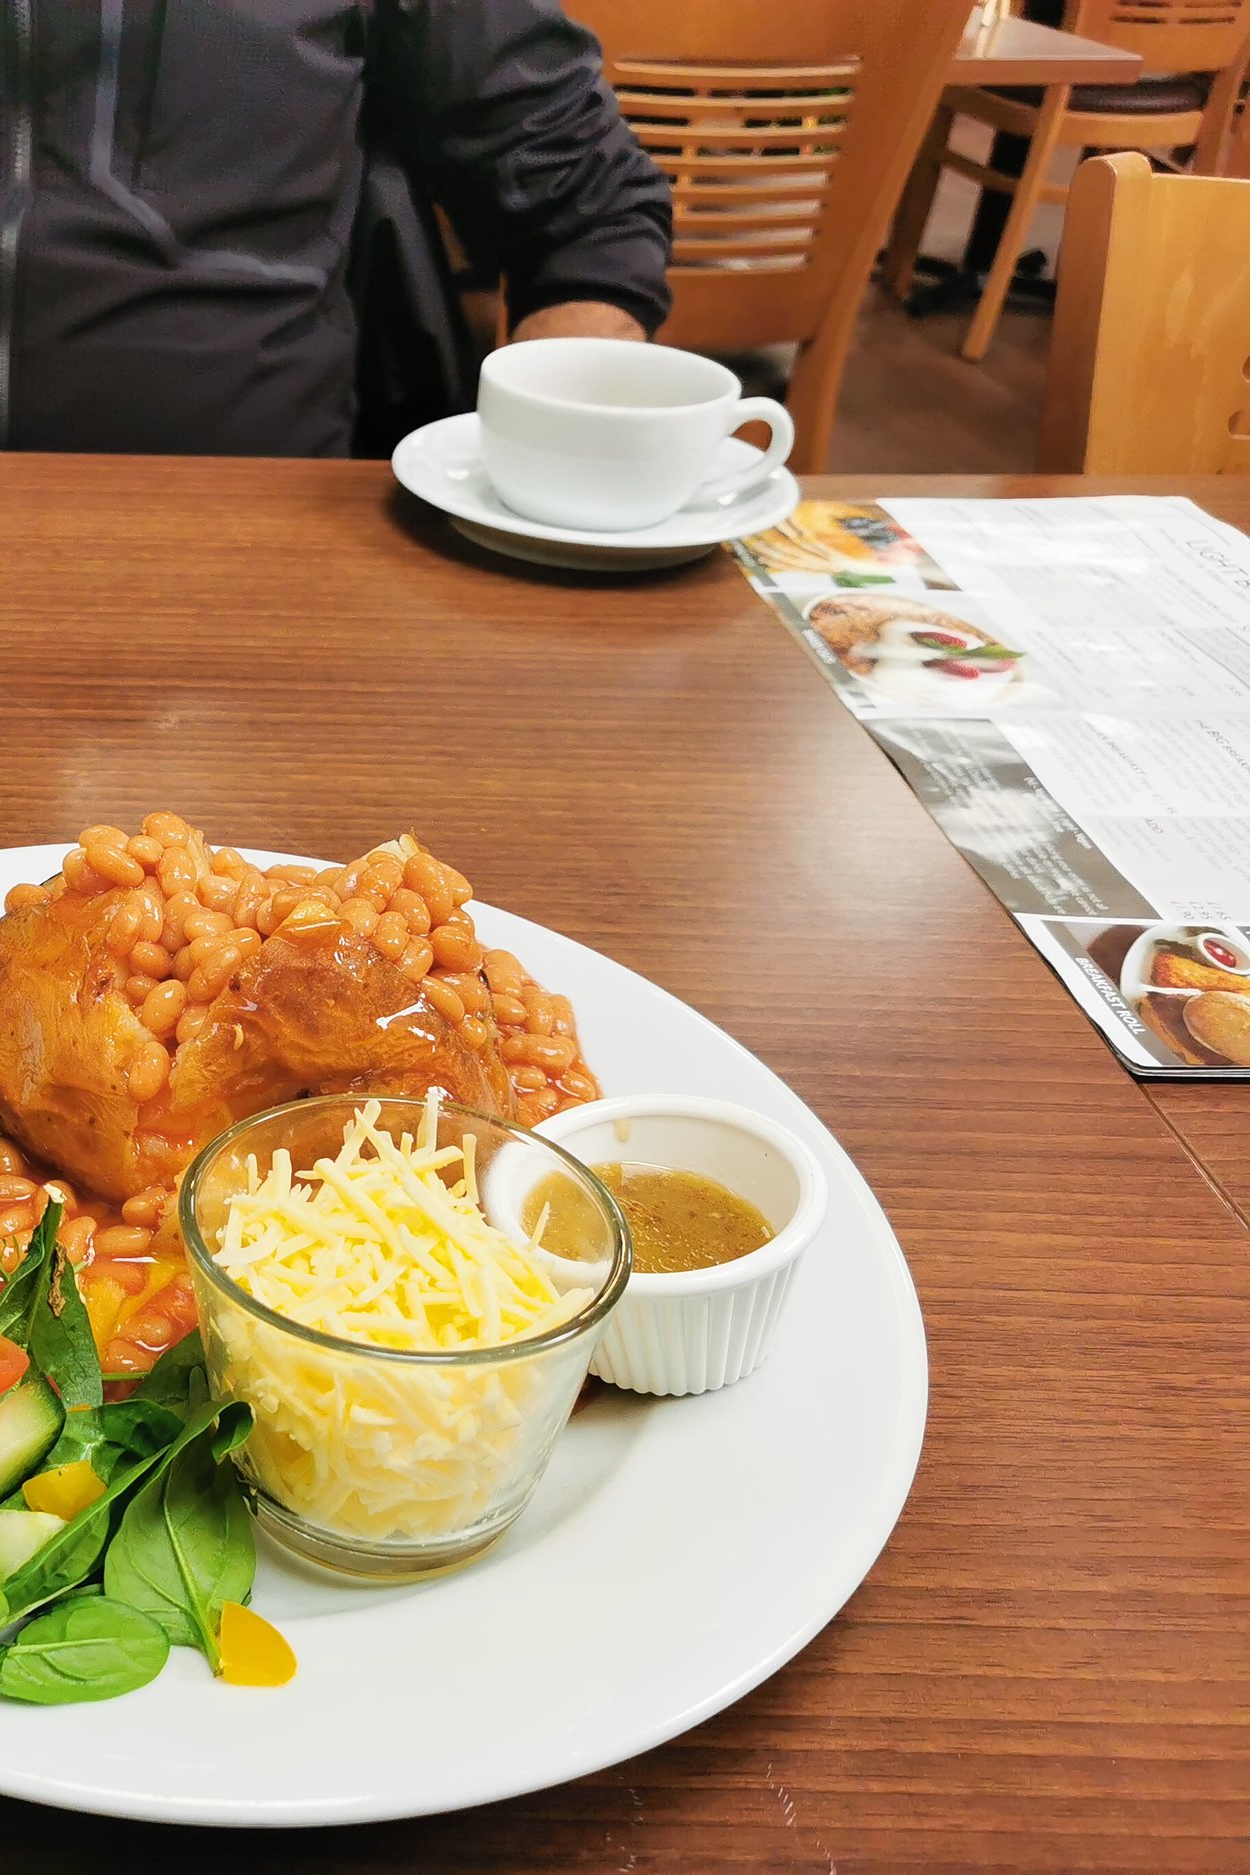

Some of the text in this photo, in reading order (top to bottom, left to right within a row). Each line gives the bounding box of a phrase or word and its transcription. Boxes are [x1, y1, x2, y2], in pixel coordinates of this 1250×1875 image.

[1185, 539, 1249, 576] LIGHT
[1074, 957, 1146, 1035] BREAKFAST ROLL
